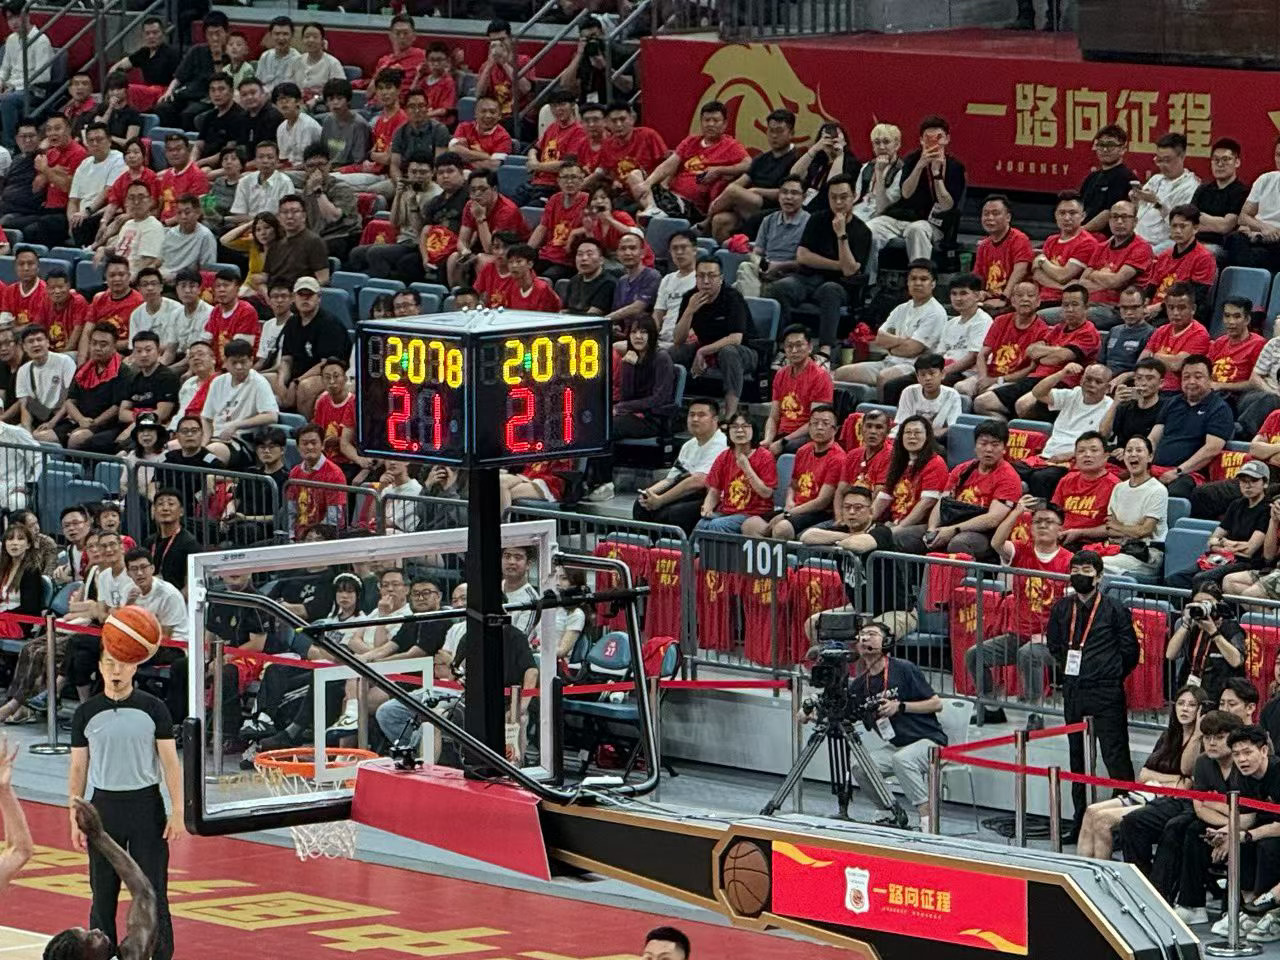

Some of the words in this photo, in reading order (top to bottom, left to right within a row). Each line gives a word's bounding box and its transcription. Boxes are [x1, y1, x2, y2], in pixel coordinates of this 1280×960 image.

[966, 83, 1212, 158] 一路向征程
[742, 539, 783, 577] 101
[872, 883, 951, 913] 一路向征程
